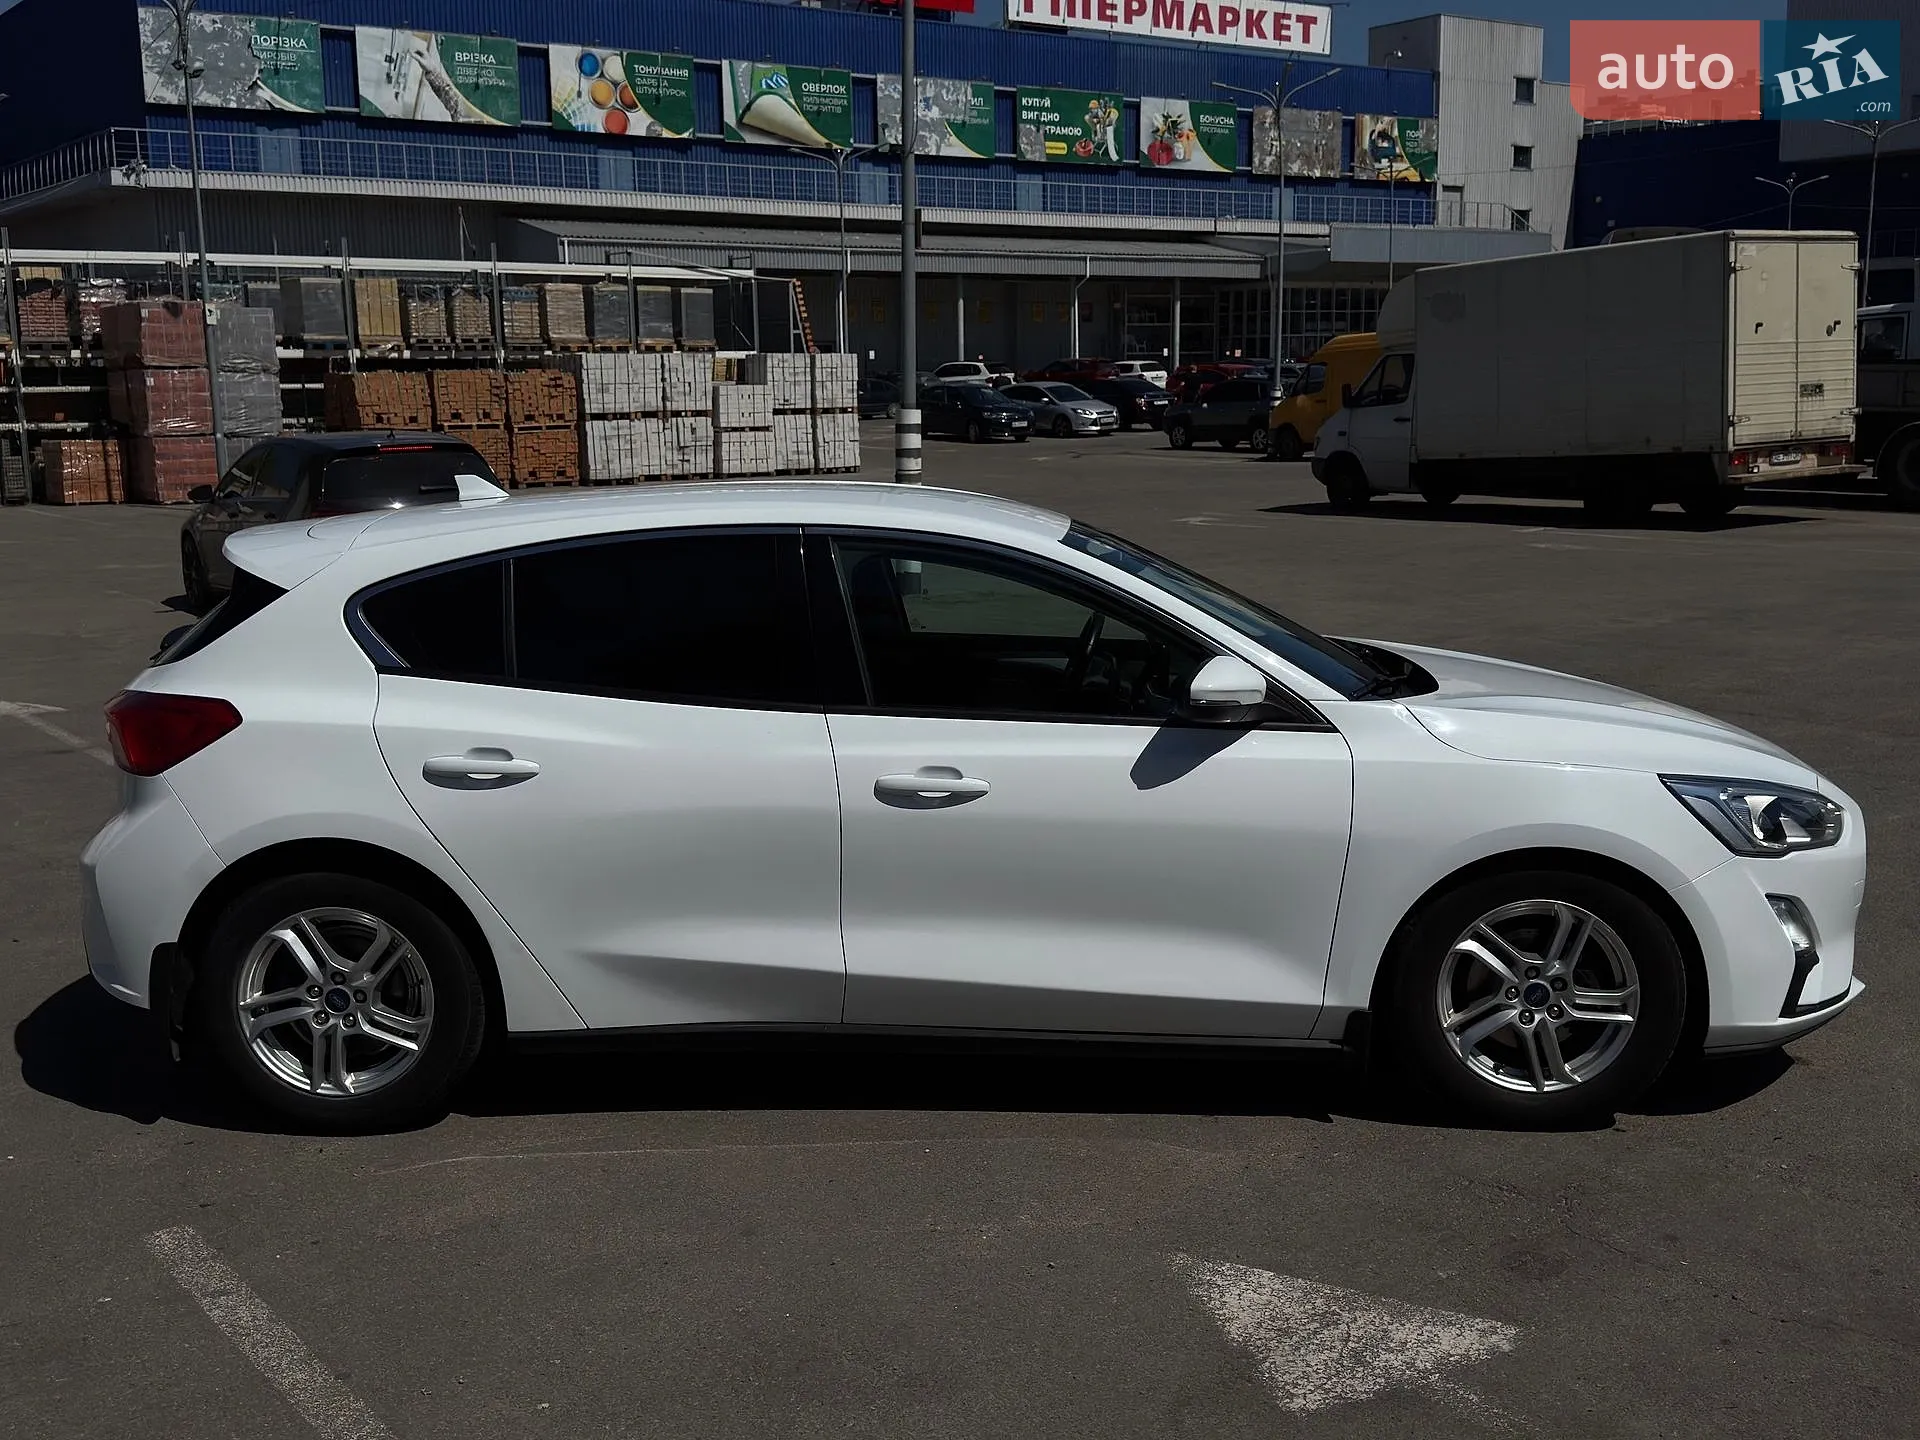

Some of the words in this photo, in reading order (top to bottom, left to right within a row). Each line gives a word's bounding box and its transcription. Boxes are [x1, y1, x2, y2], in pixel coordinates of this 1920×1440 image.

[251, 34, 308, 49] ПОРІЗКА
[455, 51, 497, 64] ВРІЗКА
[633, 64, 689, 77] ТОНУВАННЯ
[801, 82, 847, 94] ОВЕРЛОК
[1021, 96, 1051, 108] КУПУЙ
[1199, 114, 1235, 126] БОНУСНА
